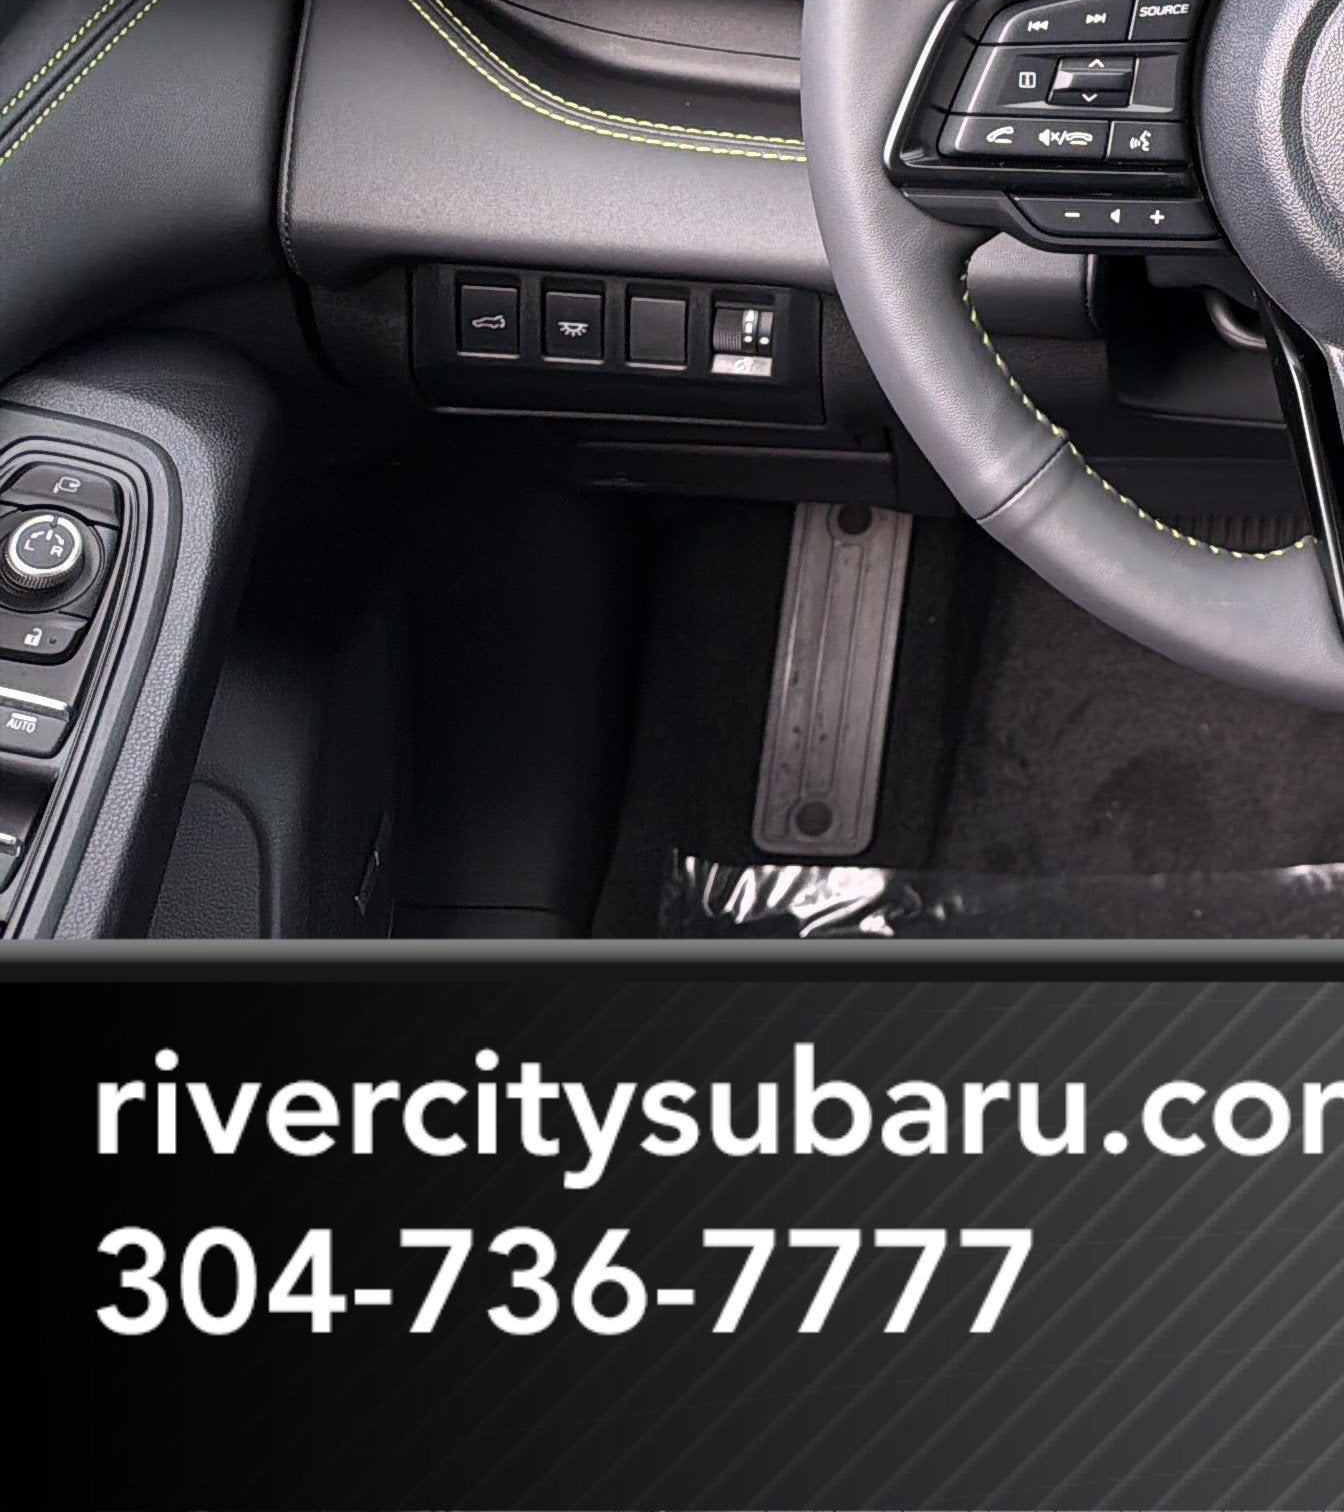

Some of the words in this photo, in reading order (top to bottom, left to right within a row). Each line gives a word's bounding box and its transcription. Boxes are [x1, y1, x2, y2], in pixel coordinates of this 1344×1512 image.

[1139, 3, 1189, 17] SOURCE
[23, 539, 35, 551] L
[50, 545, 63, 557] R
[6, 716, 37, 734] AUTO
